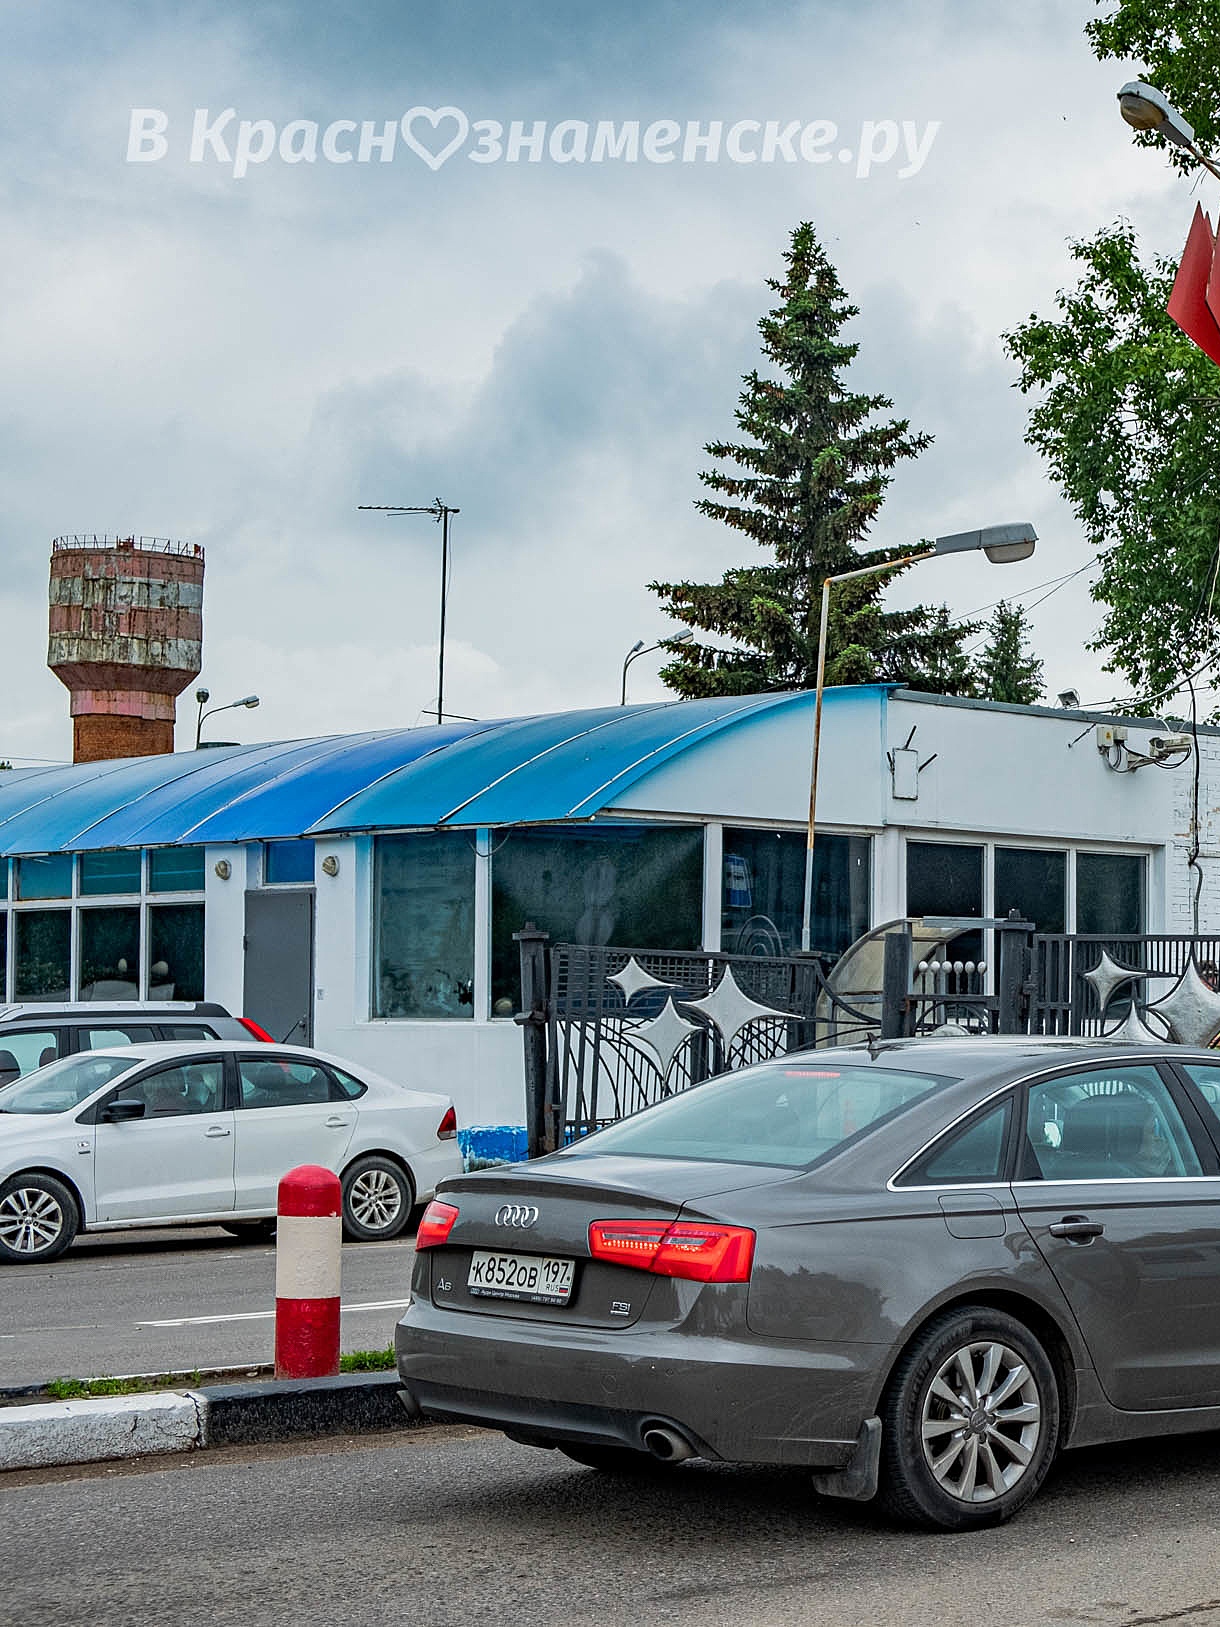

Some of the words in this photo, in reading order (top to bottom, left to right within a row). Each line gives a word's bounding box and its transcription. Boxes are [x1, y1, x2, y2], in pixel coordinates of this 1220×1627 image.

[544, 1260, 569, 1284] 197
[437, 1277, 452, 1291] A6
[546, 1284, 559, 1292] RUS
